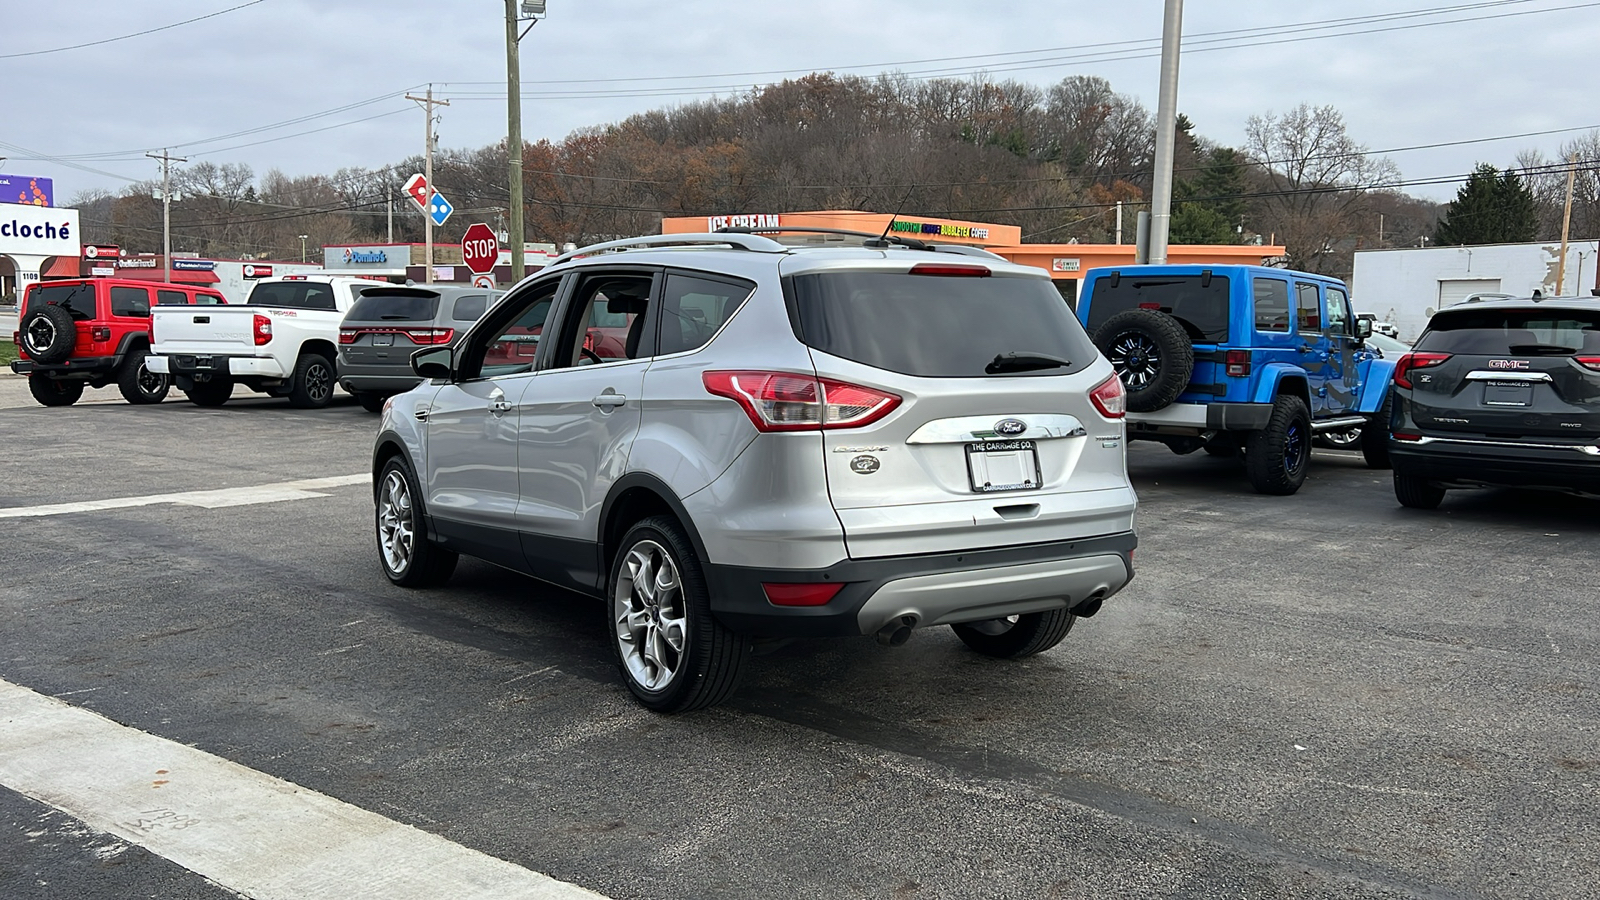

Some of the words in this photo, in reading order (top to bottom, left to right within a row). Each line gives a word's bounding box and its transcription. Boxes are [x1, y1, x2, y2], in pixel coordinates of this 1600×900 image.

[1, 220, 70, 240] cloché
[708, 216, 730, 234] ICE
[731, 214, 780, 234] CREAM
[465, 239, 495, 259] STOP
[352, 250, 387, 262] Domino's
[1488, 359, 1530, 369] GMC
[1002, 422, 1022, 433] Ford
[972, 443, 985, 451] THE
[986, 441, 1020, 450] CARRIAGE
[1020, 440, 1033, 449] CO.
